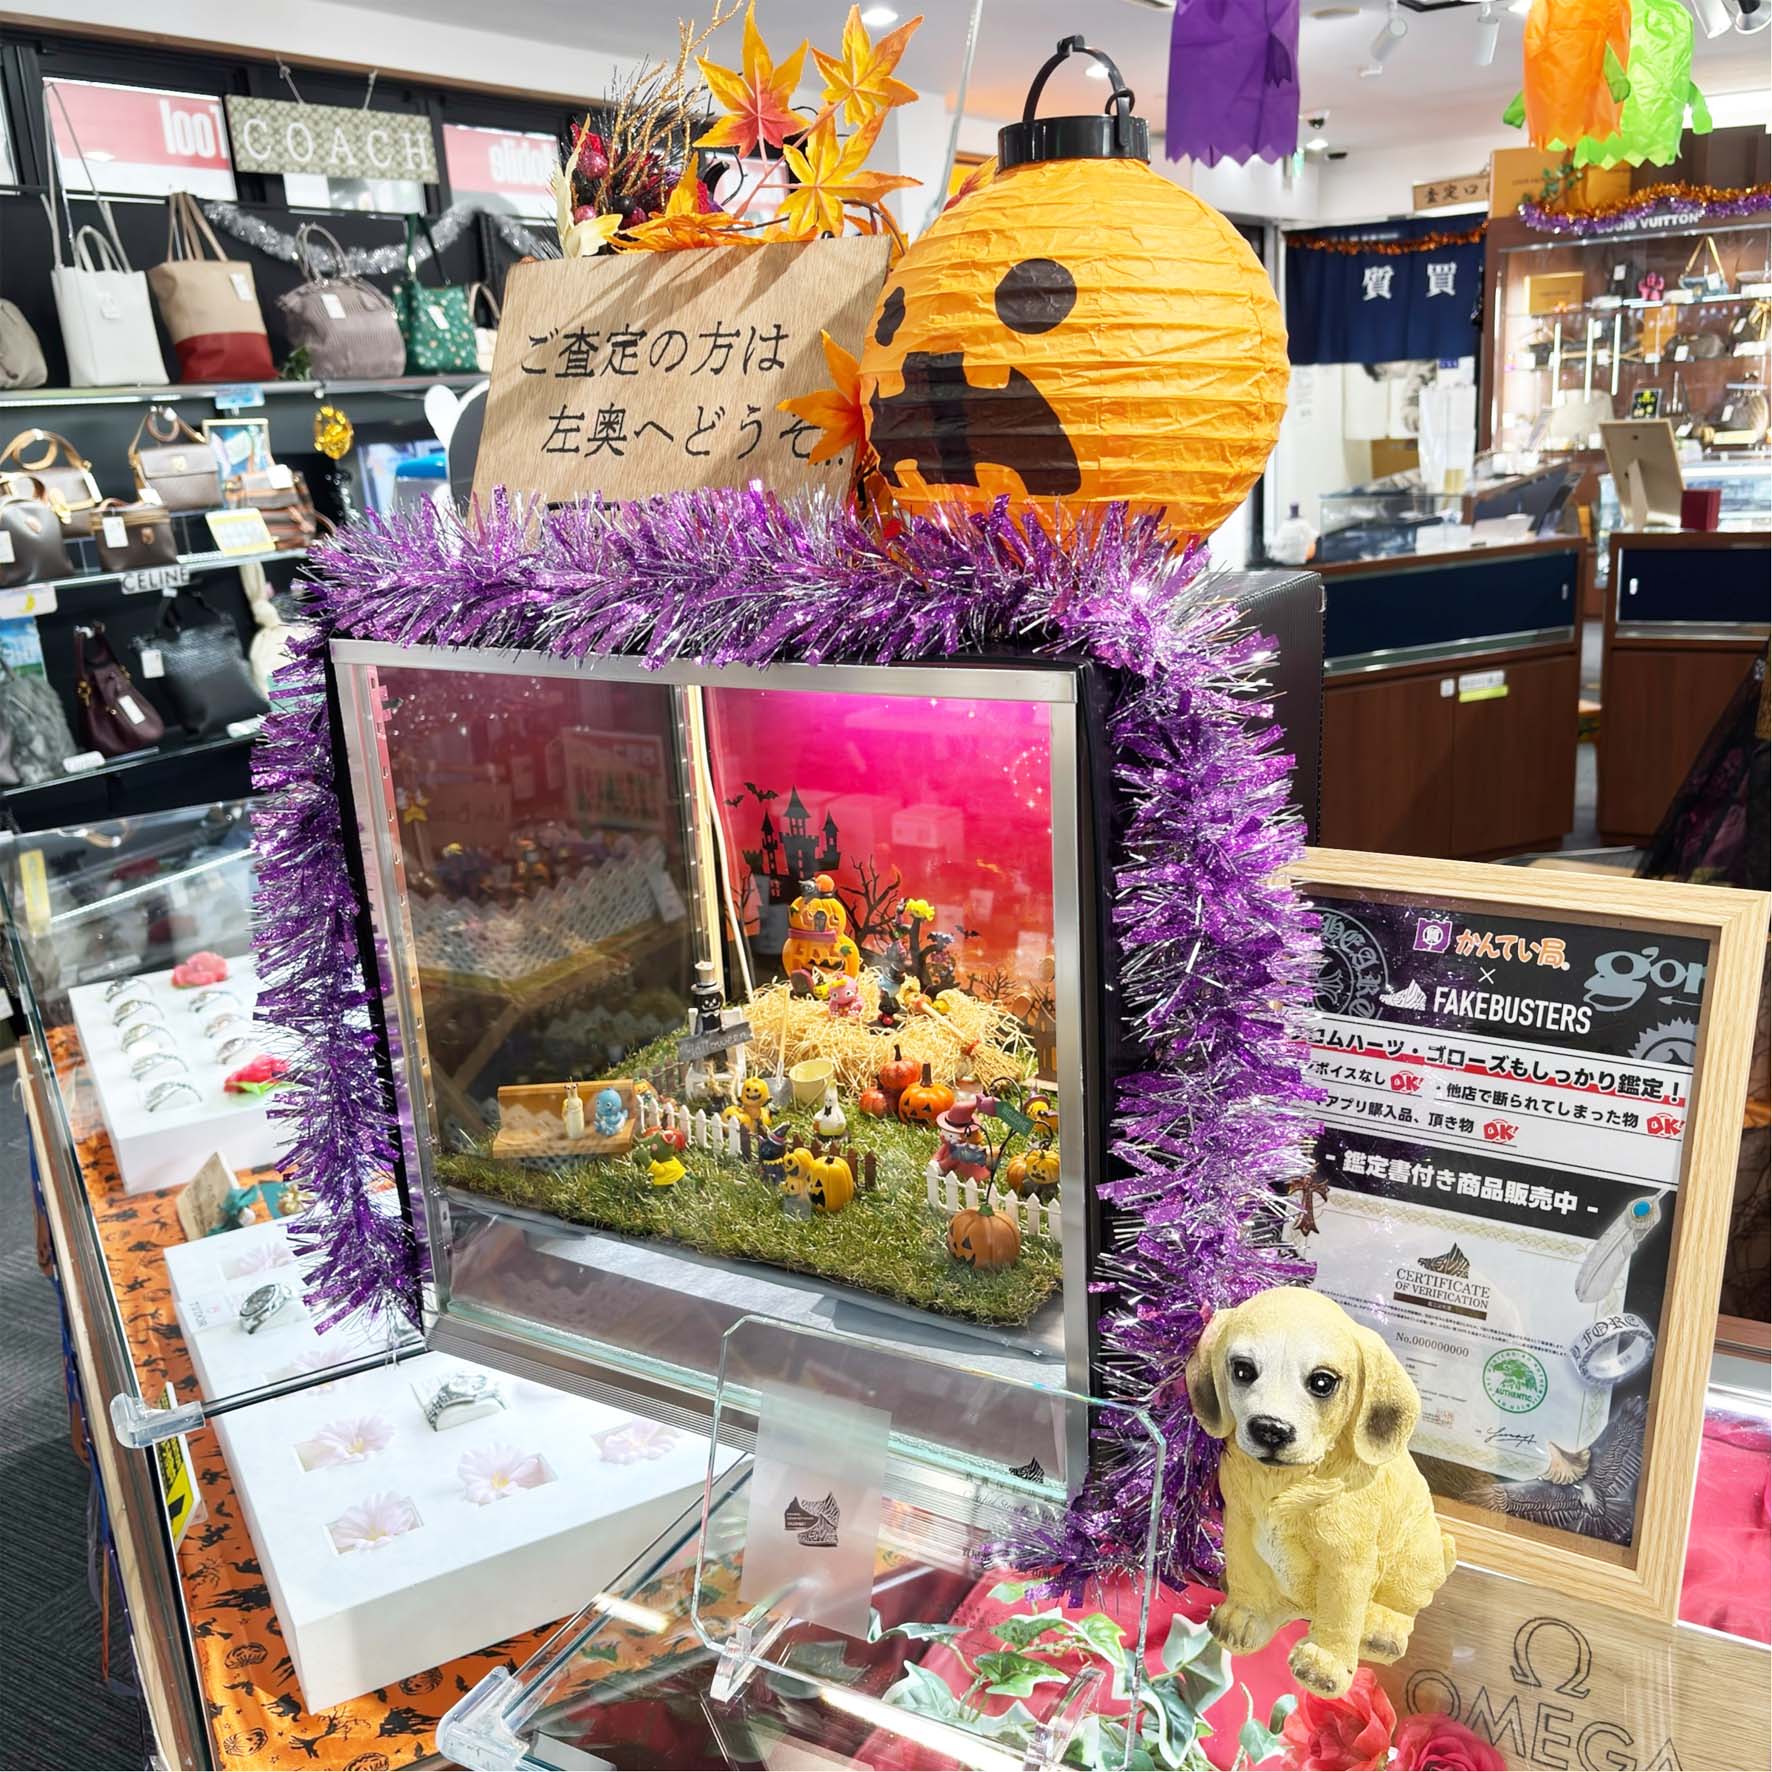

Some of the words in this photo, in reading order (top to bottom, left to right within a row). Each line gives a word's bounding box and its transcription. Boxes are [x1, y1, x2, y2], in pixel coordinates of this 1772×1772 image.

[243, 117, 430, 170] COACH
[1640, 214, 1699, 229] VUITTON
[521, 321, 789, 378] ご査定の方は
[122, 568, 189, 592] CELINE
[1433, 986, 1592, 1034] FAKEBUSTERS
[1291, 1029, 1680, 1102] ロムハーツ・ゴローズもしっかり鑑定！
[1315, 1095, 1474, 1133] アプリ購入品、頂き物
[1395, 1280, 1409, 1291] OF
[1412, 1284, 1489, 1310] VERIFICATION
[1396, 1267, 1491, 1299] CERTIFICATE
[1495, 1387, 1533, 1402] AUTHENTIC
